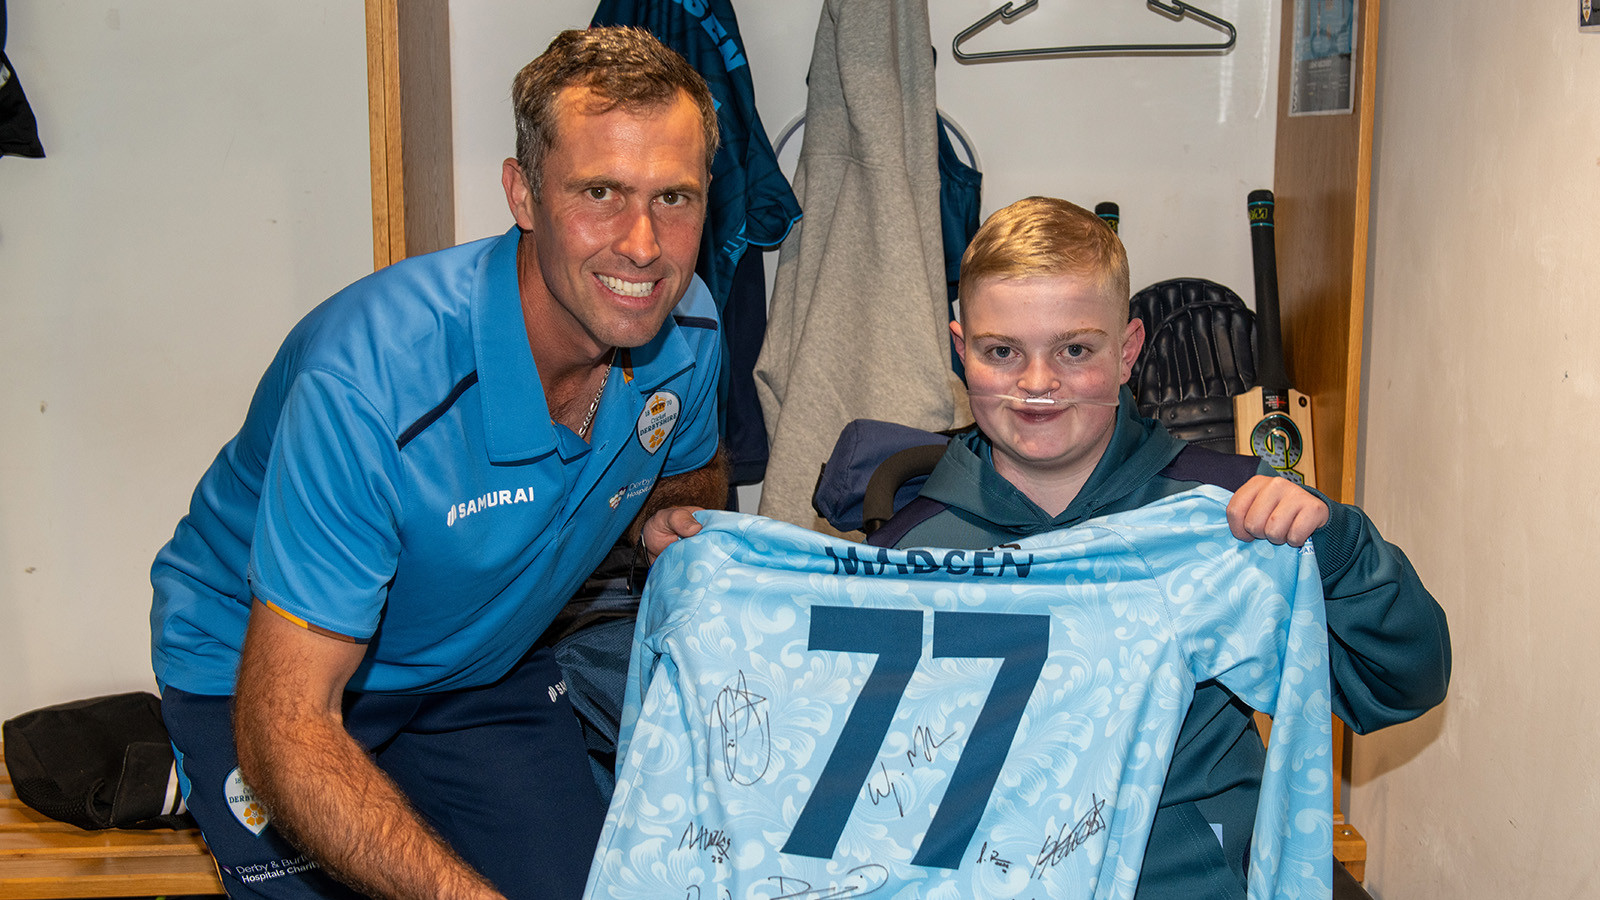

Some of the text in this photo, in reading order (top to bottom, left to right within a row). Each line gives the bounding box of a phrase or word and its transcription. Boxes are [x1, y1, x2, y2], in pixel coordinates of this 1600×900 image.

[672, 0, 747, 72] SEN
[640, 412, 678, 436] DERBYSHIRE
[458, 486, 535, 519] SAMURAI
[781, 604, 1051, 869] 77
[235, 863, 268, 875] Derby
[270, 860, 279, 869] &
[241, 869, 285, 884] Hospitals
